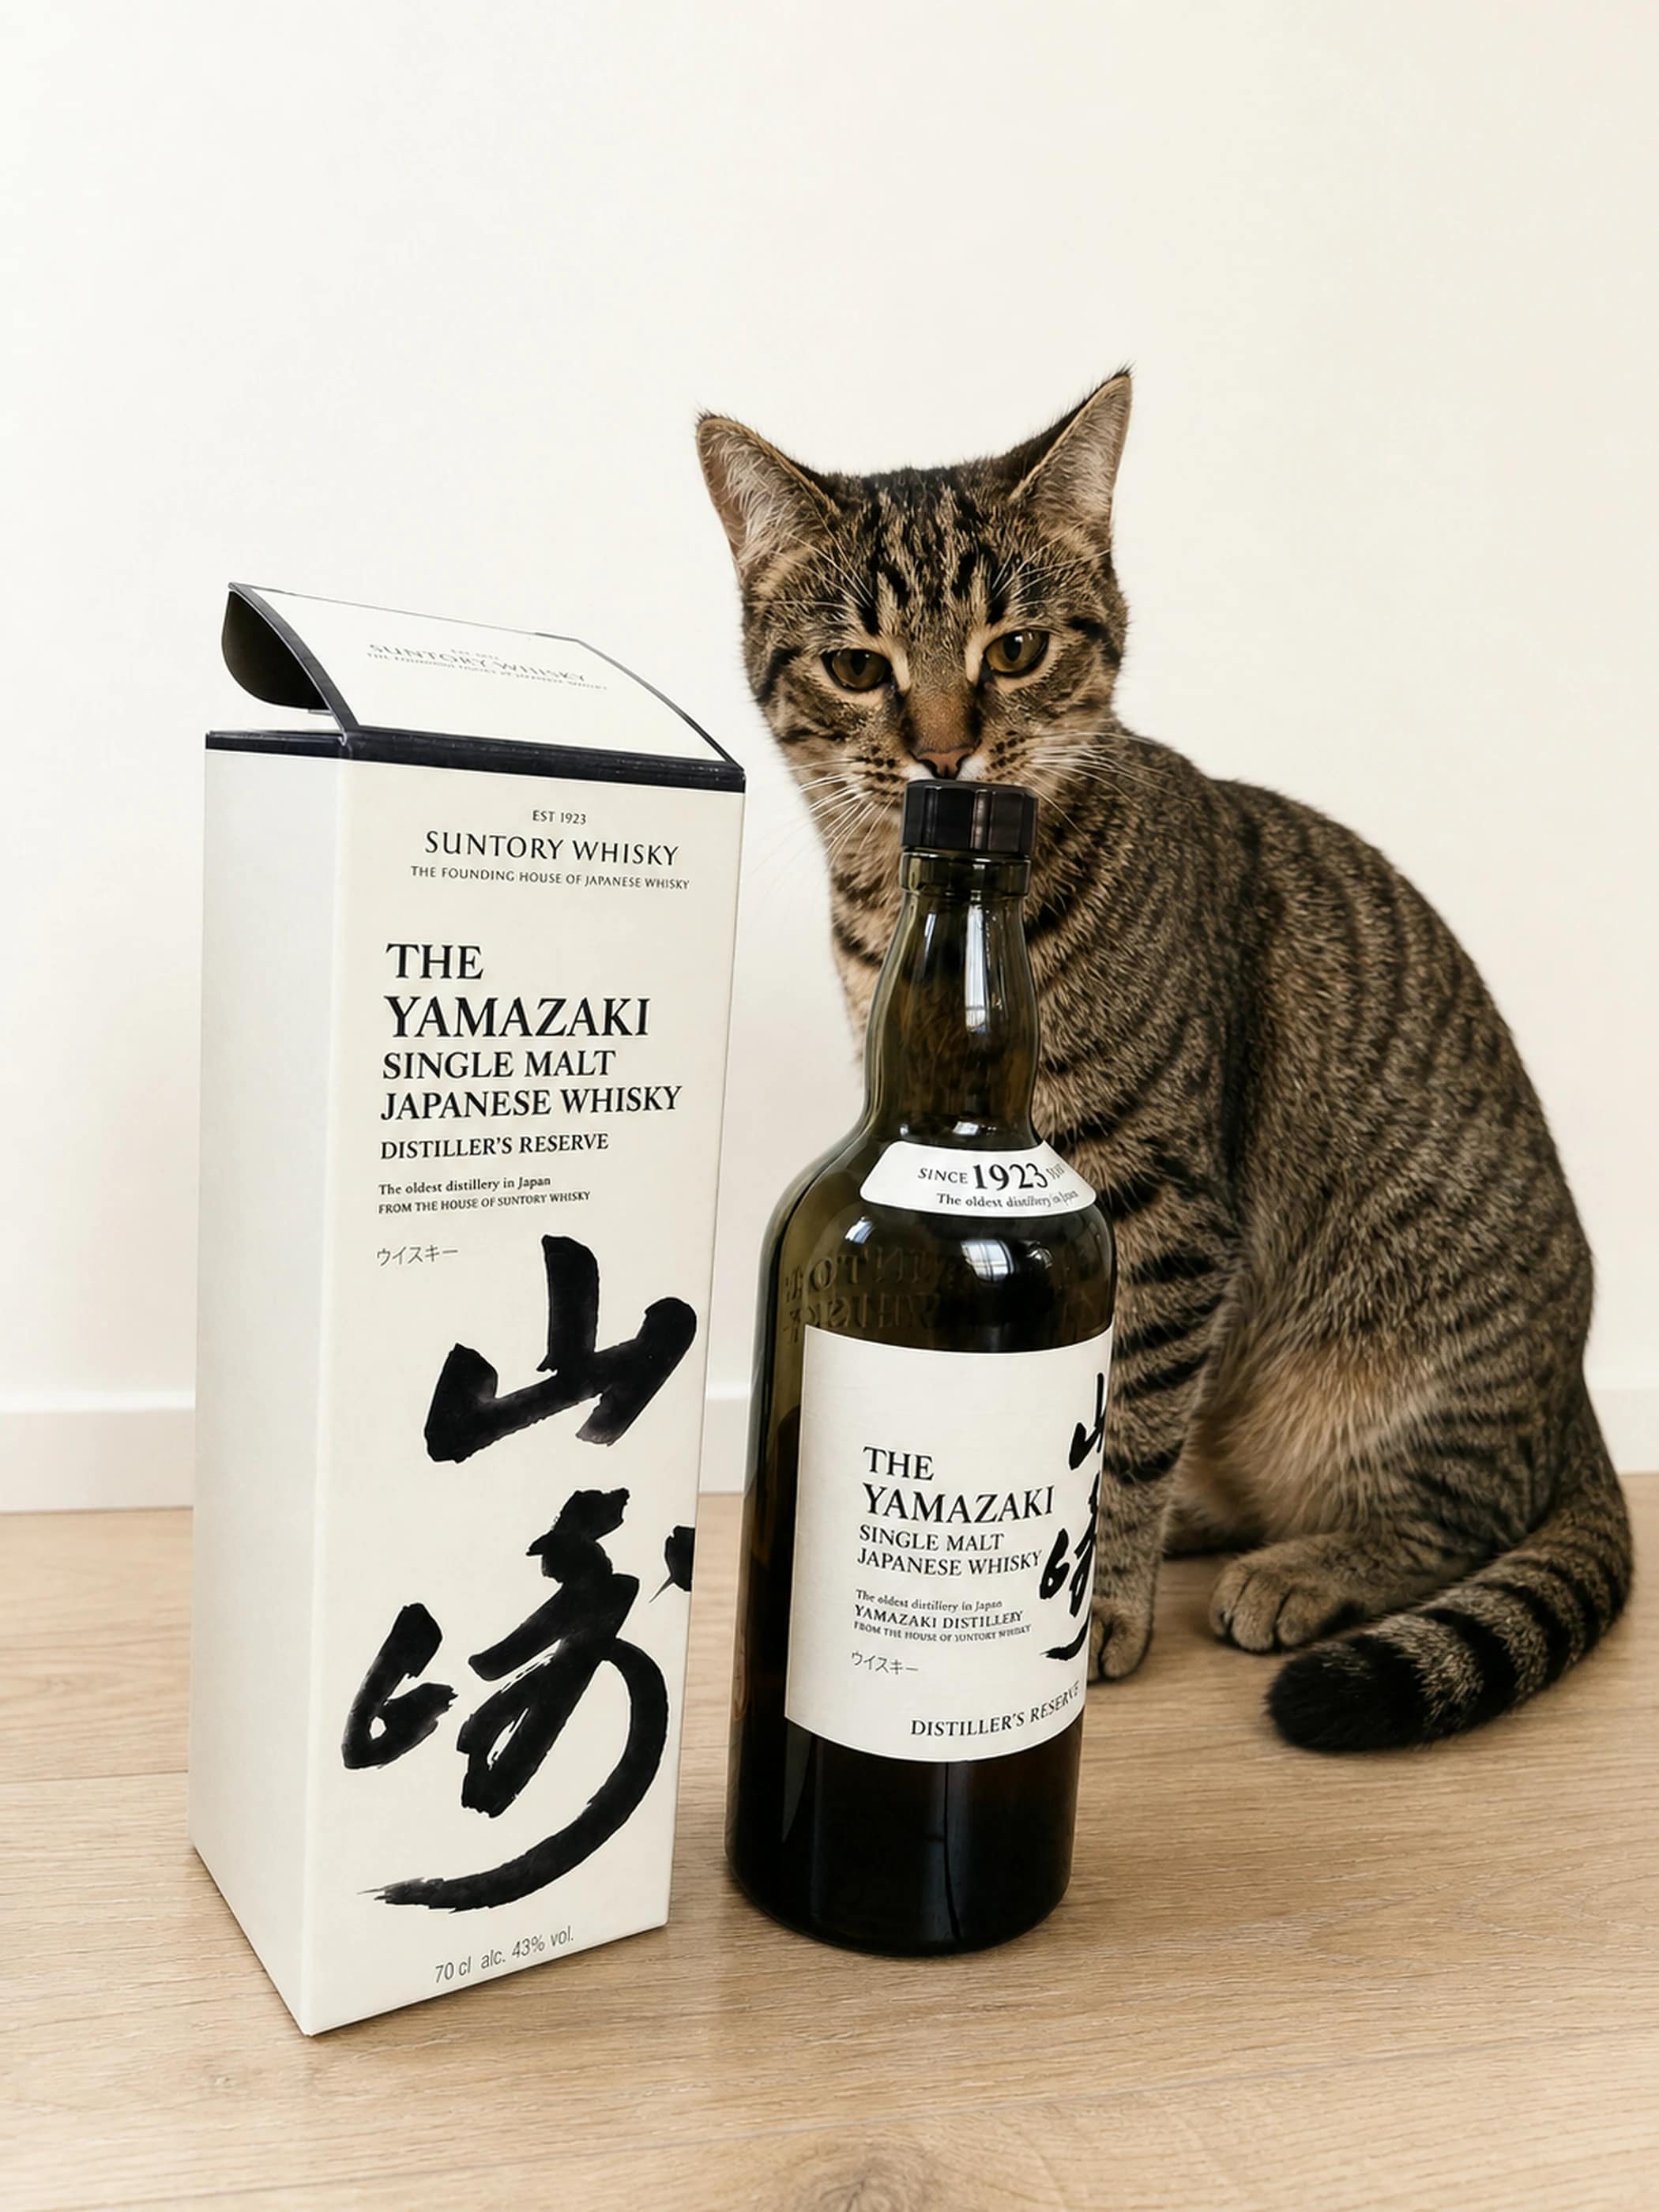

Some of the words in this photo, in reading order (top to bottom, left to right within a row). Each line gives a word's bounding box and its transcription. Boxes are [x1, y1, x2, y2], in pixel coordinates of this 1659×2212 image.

[532, 810, 555, 822] EST
[560, 812, 587, 825] 1923
[425, 830, 564, 860] SUNTORY
[572, 840, 679, 866] WHISKY
[411, 866, 436, 878] THE
[442, 867, 514, 882] FOUNDING
[519, 872, 562, 884] HOUSE
[566, 875, 583, 885] OF
[585, 875, 641, 888] JAPANESE
[645, 878, 690, 890] WHISKY
[386, 943, 483, 980] THE
[384, 995, 650, 1037] YAMAZAKI
[382, 1051, 514, 1079] SINGLE
[525, 1051, 616, 1076] MALT
[381, 1090, 551, 1120] JAPANESE
[560, 1085, 682, 1113] WHISKY
[381, 1136, 512, 1159] DISTILLER'S
[519, 1133, 608, 1153] RESERVE
[379, 1184, 401, 1194] The
[405, 1183, 442, 1194] oldest
[446, 1179, 500, 1192] distillery
[503, 1177, 514, 1188] in
[517, 1176, 551, 1190] Japan
[918, 1167, 968, 1184] SINCE
[973, 1163, 1048, 1191] 1923
[378, 1203, 412, 1214] FROM
[416, 1202, 438, 1212] THE
[441, 1199, 478, 1210] HOUSE
[481, 1198, 495, 1207] OF
[498, 1194, 547, 1206] SUNTORY
[549, 1191, 590, 1202] WHISKY
[937, 1193, 961, 1206] The
[965, 1195, 1003, 1208] oldest
[377, 1244, 458, 1267] ウイスキー
[863, 1446, 934, 1481] THE
[863, 1483, 1054, 1524] YAMAZAKI
[859, 1525, 939, 1551] SINGLE
[946, 1533, 1004, 1551] MALT
[857, 1548, 961, 1576] JAPANESE
[969, 1550, 1042, 1575] WHISKY
[856, 1589, 875, 1603] The
[878, 1595, 908, 1608] oldest
[961, 1601, 972, 1611] in
[855, 1604, 936, 1628] YAMAZAKI
[854, 1621, 881, 1635] FROM
[939, 1634, 952, 1642] OF
[851, 1650, 919, 1675] ウイスキー
[911, 1711, 1025, 1736] DISTILLER'S
[1030, 1680, 1079, 1723] RESERVE
[435, 1962, 454, 1984] 70
[458, 1955, 472, 1976] cl
[480, 1949, 506, 1969] alc.
[512, 1934, 545, 1958] 43%
[551, 1925, 574, 1947] vol.
